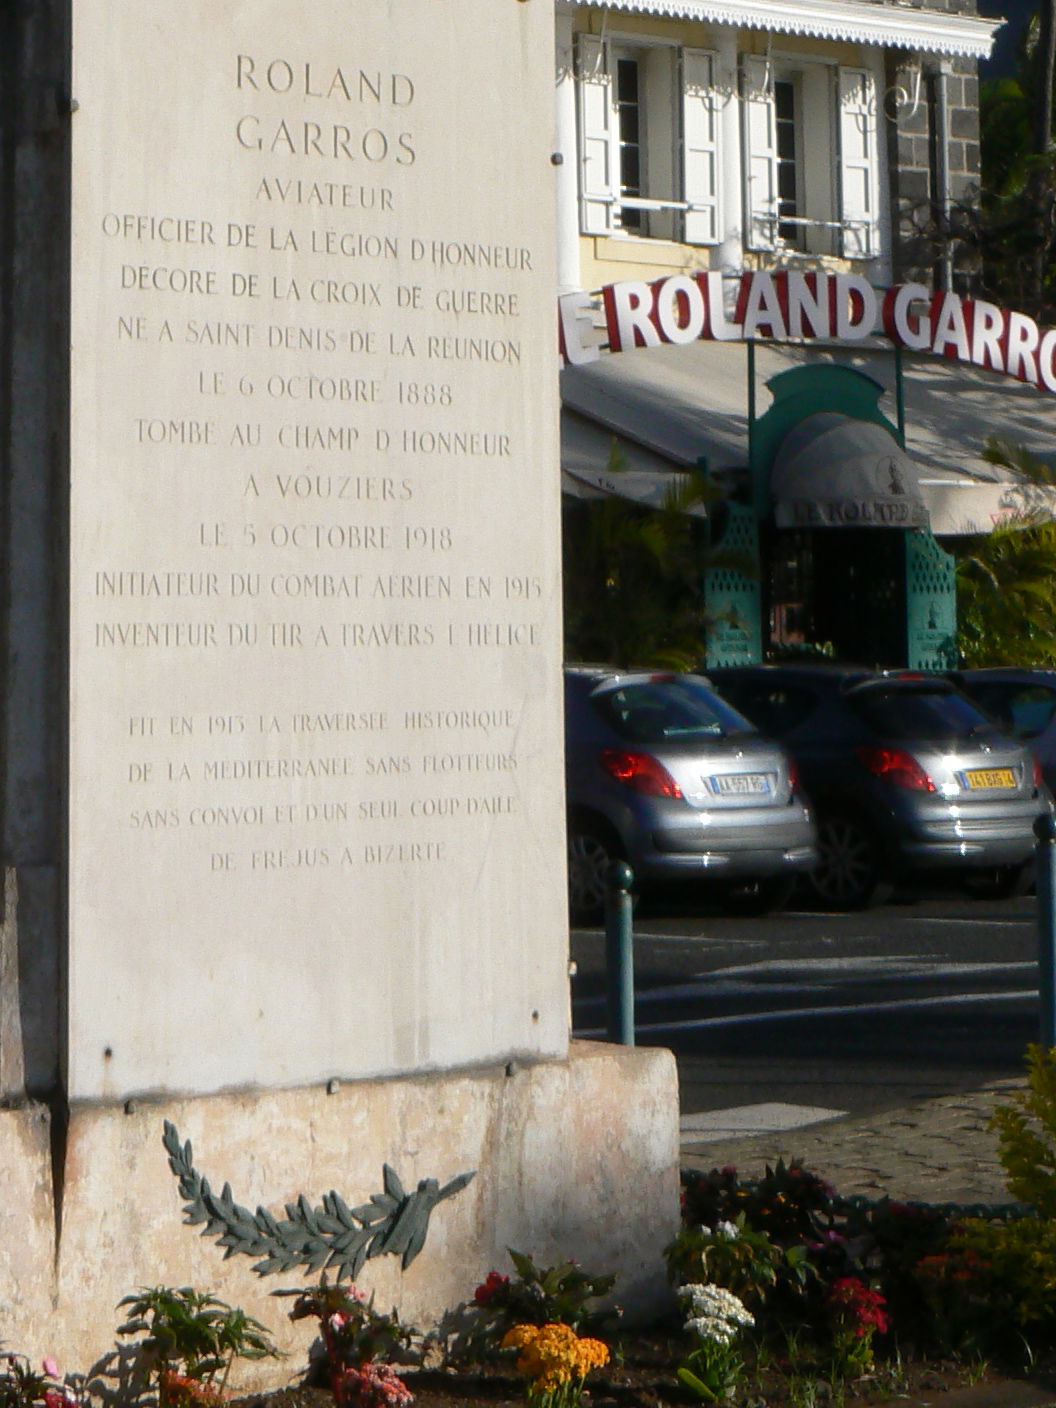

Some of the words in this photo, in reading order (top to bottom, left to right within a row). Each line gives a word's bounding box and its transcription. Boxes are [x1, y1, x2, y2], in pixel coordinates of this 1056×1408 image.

[235, 54, 415, 107] ROLAND
[235, 114, 416, 166] GARROS
[255, 177, 395, 212] AVIATEUR
[102, 212, 215, 245] OFFICIER
[227, 222, 258, 248] DE
[270, 227, 298, 251] LA
[231, 273, 260, 298] DE
[273, 276, 300, 301] LA
[310, 279, 382, 306] CROIX
[397, 285, 423, 309] DE
[435, 290, 521, 318] GUERRE
[602, 270, 878, 352] ROLAND
[158, 319, 174, 343] A
[185, 320, 254, 349] SAINT
[268, 325, 338, 355] DENIS
[349, 330, 377, 355] DE
[390, 333, 416, 358] LA
[199, 371, 226, 396] LE
[239, 374, 254, 397] 6
[267, 374, 384, 403] OCTOBRE
[399, 381, 452, 407] 1888
[230, 423, 262, 447] AU
[278, 423, 359, 452] CHAMP
[243, 473, 260, 497] A
[276, 473, 413, 501] VOUZIERS
[200, 523, 227, 547] LE
[243, 523, 257, 547] 5
[270, 523, 391, 550] OCTOBRE
[405, 525, 453, 551] 1918
[95, 571, 219, 597] INITIATEUR
[230, 572, 261, 598] DU
[270, 574, 362, 598] COMBAT
[465, 575, 492, 599] EN
[505, 575, 542, 600] 1915
[95, 622, 217, 648] INVENTEUR
[228, 622, 259, 648] DU
[269, 622, 303, 649] TIR
[315, 624, 329, 648] A
[339, 623, 435, 648] TRAVERS
[128, 715, 157, 737] FIT
[170, 715, 194, 736] EN
[208, 714, 246, 735] 1913
[258, 714, 281, 734] LA
[404, 709, 514, 737] HISTORIQUE
[128, 762, 153, 783] DE
[168, 761, 192, 782] LA
[365, 755, 411, 776] SANS
[423, 752, 519, 776] FLOTTEURS
[129, 808, 181, 830] SANS
[189, 805, 264, 827] CONVOI
[275, 804, 297, 825] ET
[358, 799, 403, 820] SEUL
[410, 798, 460, 818] COUP
[210, 852, 237, 872] DE
[340, 846, 353, 866] A
[364, 841, 447, 865] BIZERTE
